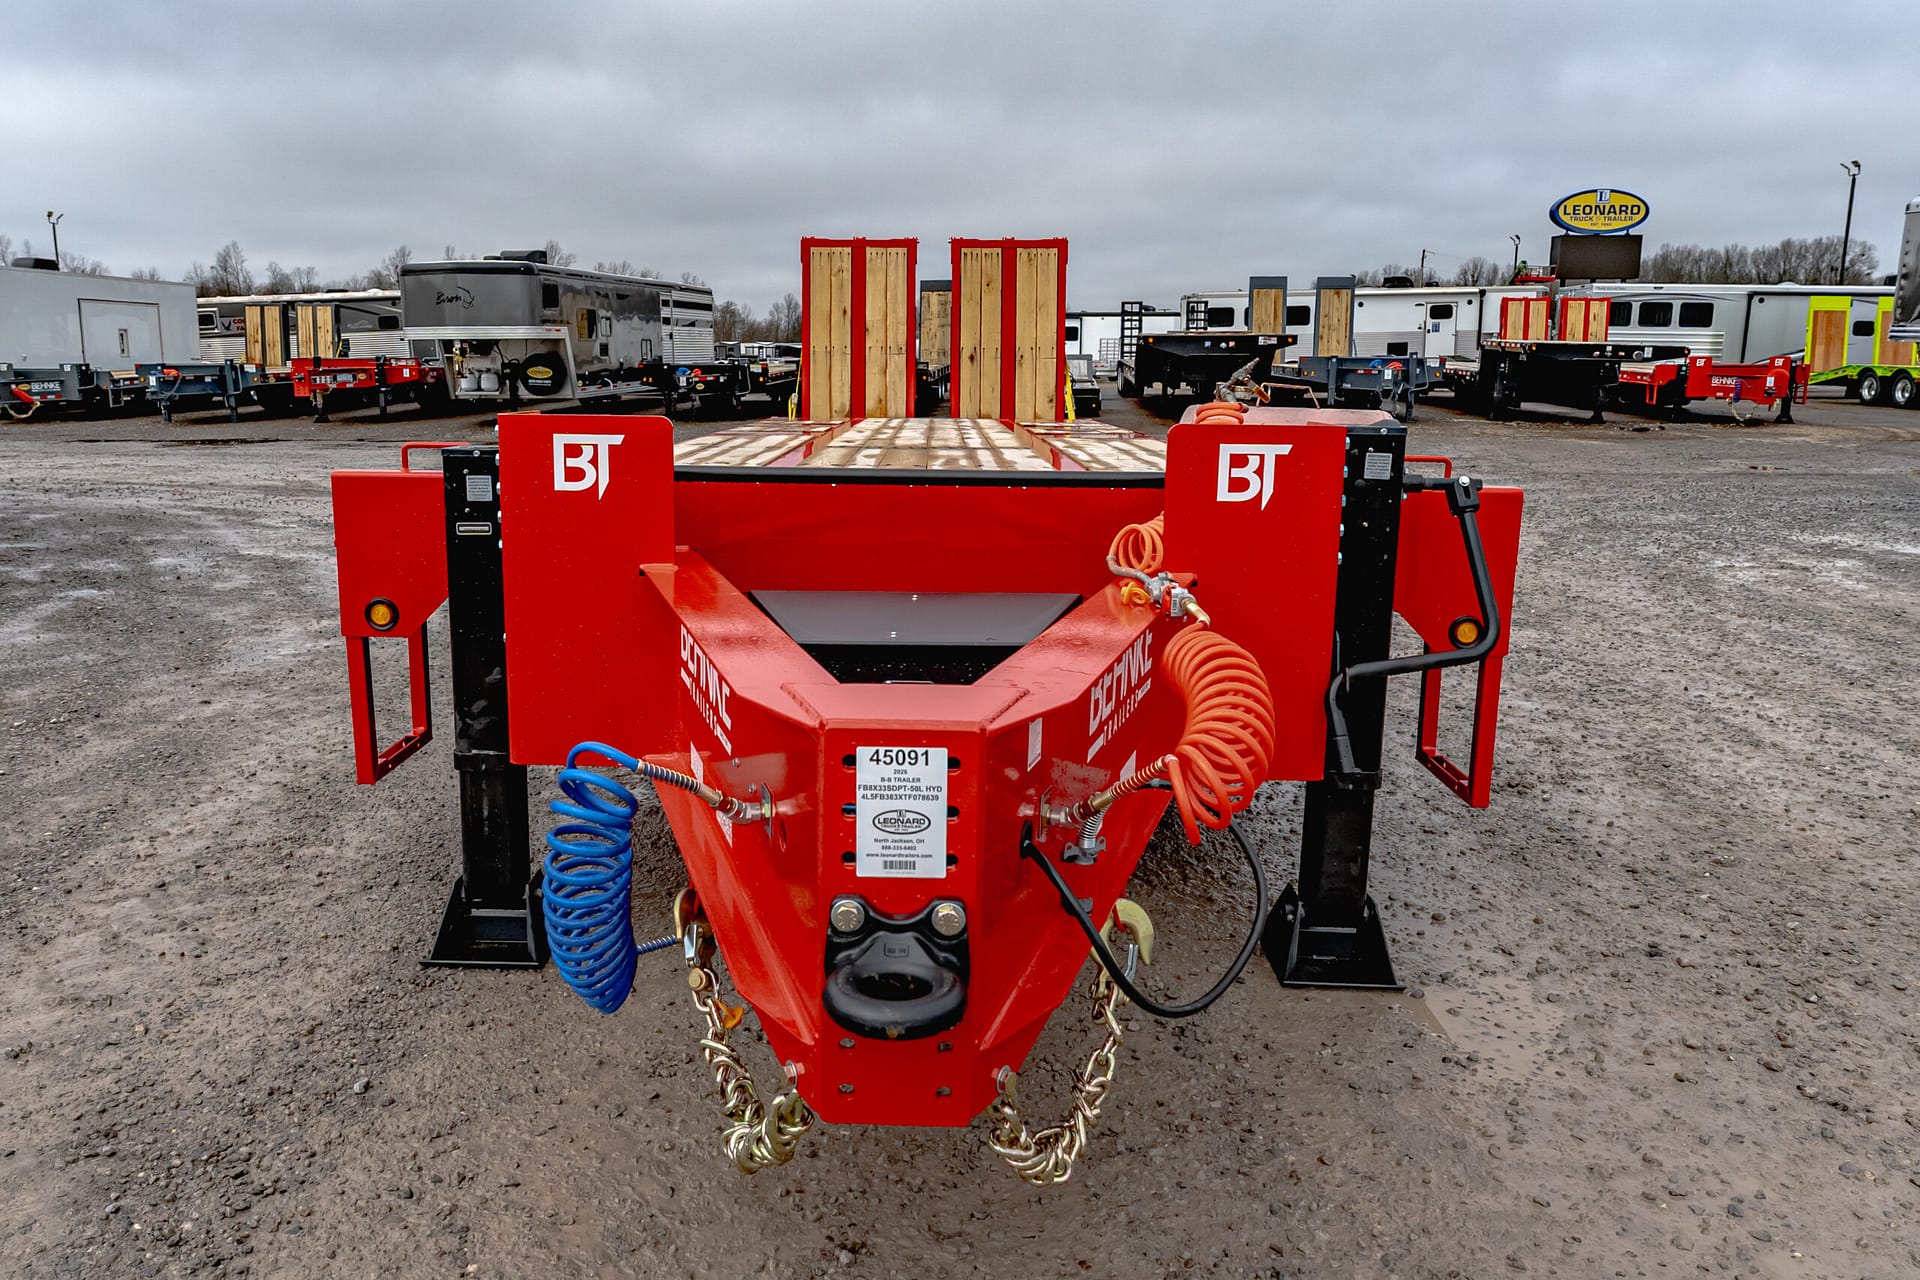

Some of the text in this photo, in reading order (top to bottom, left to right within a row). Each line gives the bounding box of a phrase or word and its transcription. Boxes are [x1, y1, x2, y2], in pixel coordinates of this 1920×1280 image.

[1563, 204, 1641, 216] LEONARD
[553, 433, 625, 501] BT
[1216, 443, 1293, 511] BT
[1089, 629, 1153, 737] BEHNKE
[1103, 689, 1139, 745] TRAILERS
[869, 748, 929, 766] 45091
[858, 784, 924, 792] FB8X33SDPT-50L
